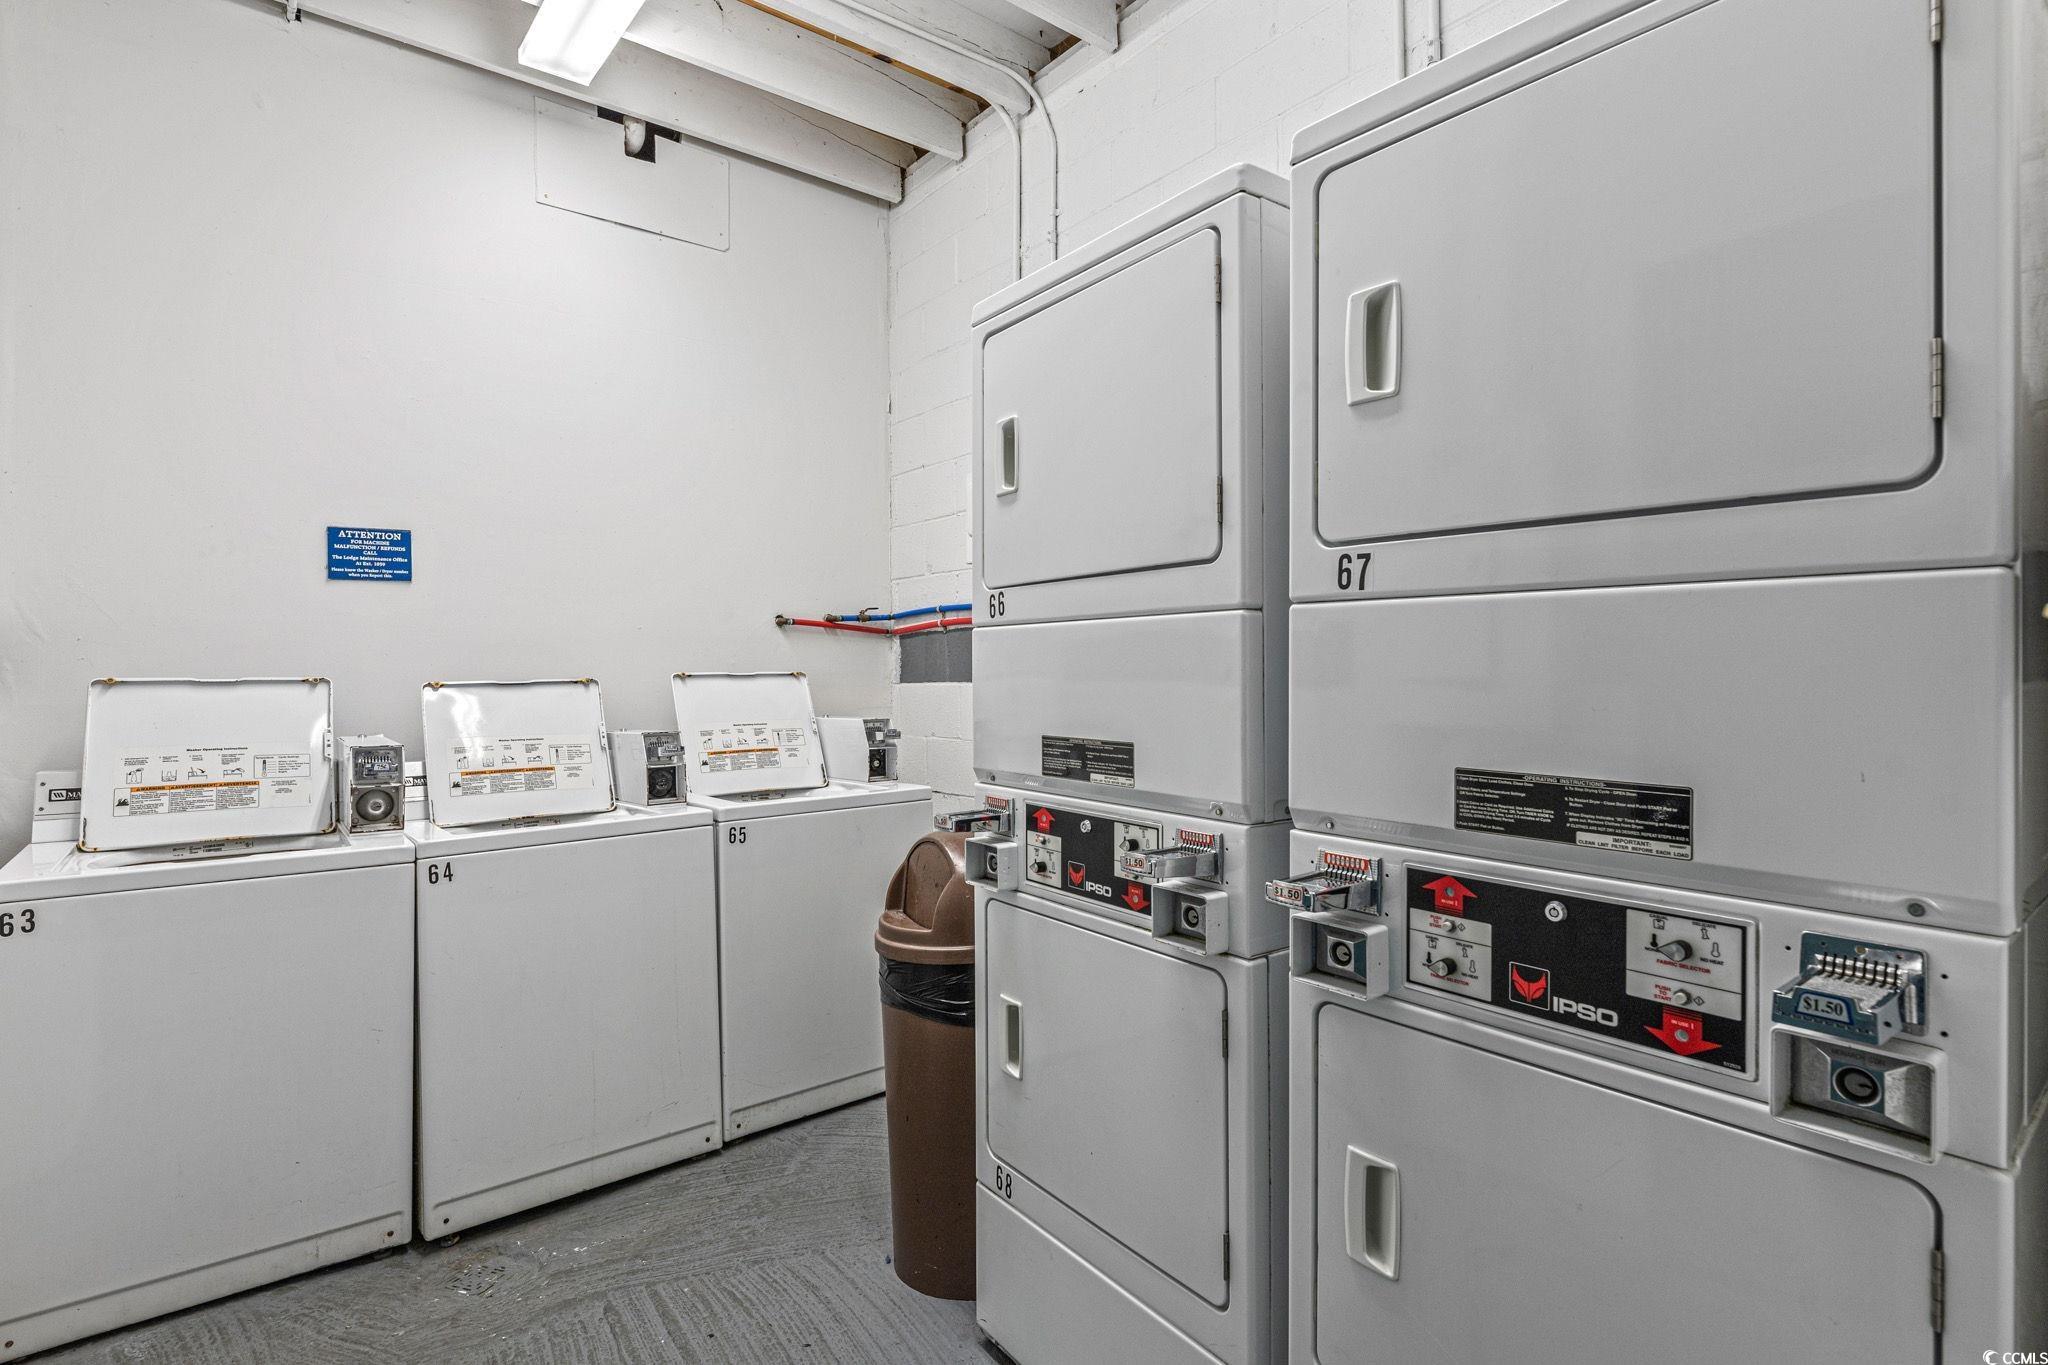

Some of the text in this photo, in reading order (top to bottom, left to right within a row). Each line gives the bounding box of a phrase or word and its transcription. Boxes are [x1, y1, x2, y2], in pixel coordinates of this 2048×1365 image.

[338, 530, 401, 540] ATTENTION
[1338, 553, 1371, 590] 67
[990, 592, 1004, 618] 66
[729, 827, 746, 843] 65
[1613, 838, 1651, 847] IMPORTANT:
[1125, 858, 1143, 867] $1.50
[429, 862, 453, 884] 64
[1086, 881, 1111, 897] IPSO
[1274, 886, 1299, 899] $1.50
[0, 909, 35, 937] 63
[1692, 921, 1716, 930] DELICATE
[1656, 958, 1711, 974] FABRIC SELECTOR
[1447, 977, 1469, 986] SELECTOR
[1654, 993, 1672, 1002] START
[1553, 996, 1618, 1027] IPSO
[1802, 996, 1843, 1017] $1.50
[997, 1165, 1012, 1199] 68
